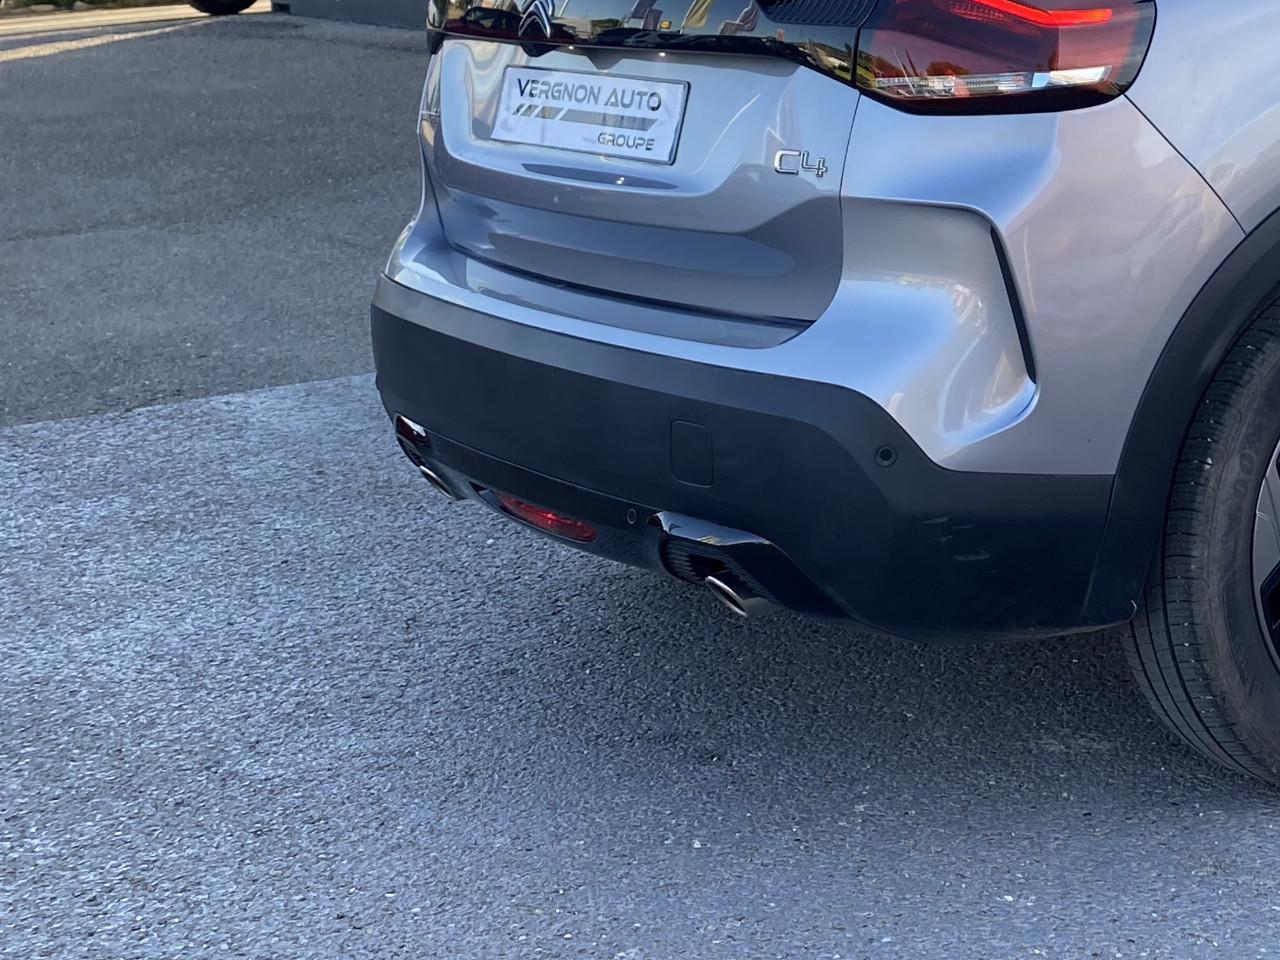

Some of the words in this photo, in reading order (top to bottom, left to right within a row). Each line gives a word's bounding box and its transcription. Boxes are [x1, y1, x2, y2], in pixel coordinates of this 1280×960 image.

[517, 78, 603, 105] VERGNON
[604, 87, 662, 112] AUTO
[597, 132, 655, 151] GROUPE
[774, 149, 829, 178] C4
